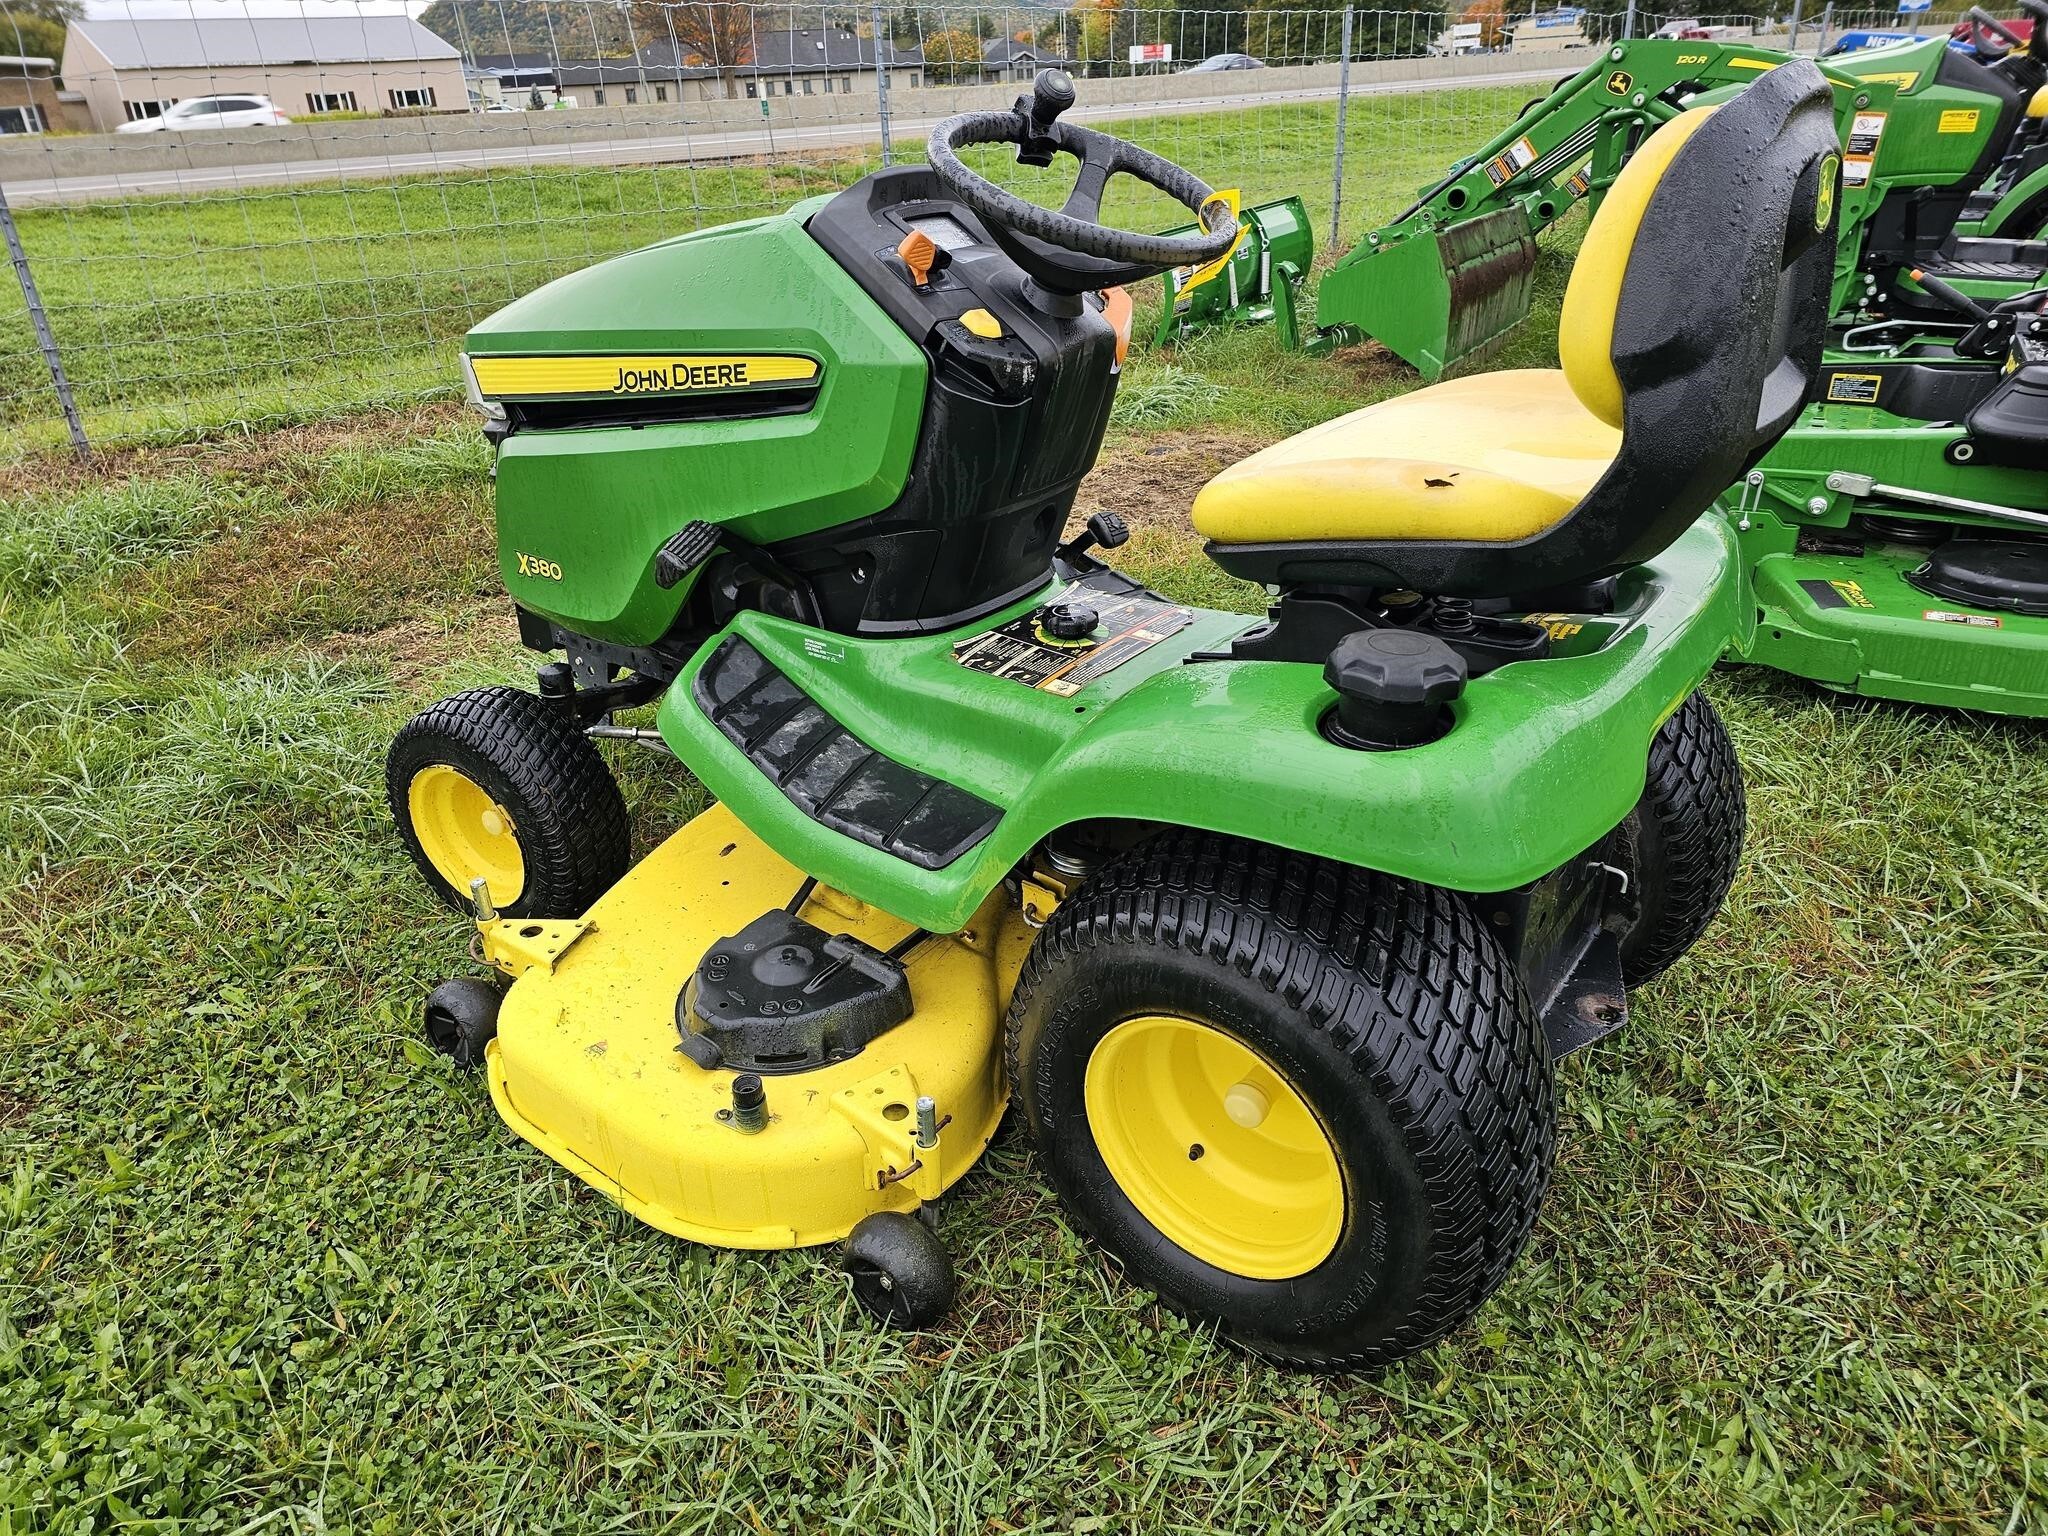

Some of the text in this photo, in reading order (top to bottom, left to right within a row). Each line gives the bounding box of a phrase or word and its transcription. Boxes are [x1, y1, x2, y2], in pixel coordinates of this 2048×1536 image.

[613, 363, 748, 391] JOHN DEERE
[515, 551, 562, 581] X380
[1036, 985, 1100, 1129] CARLISLE
